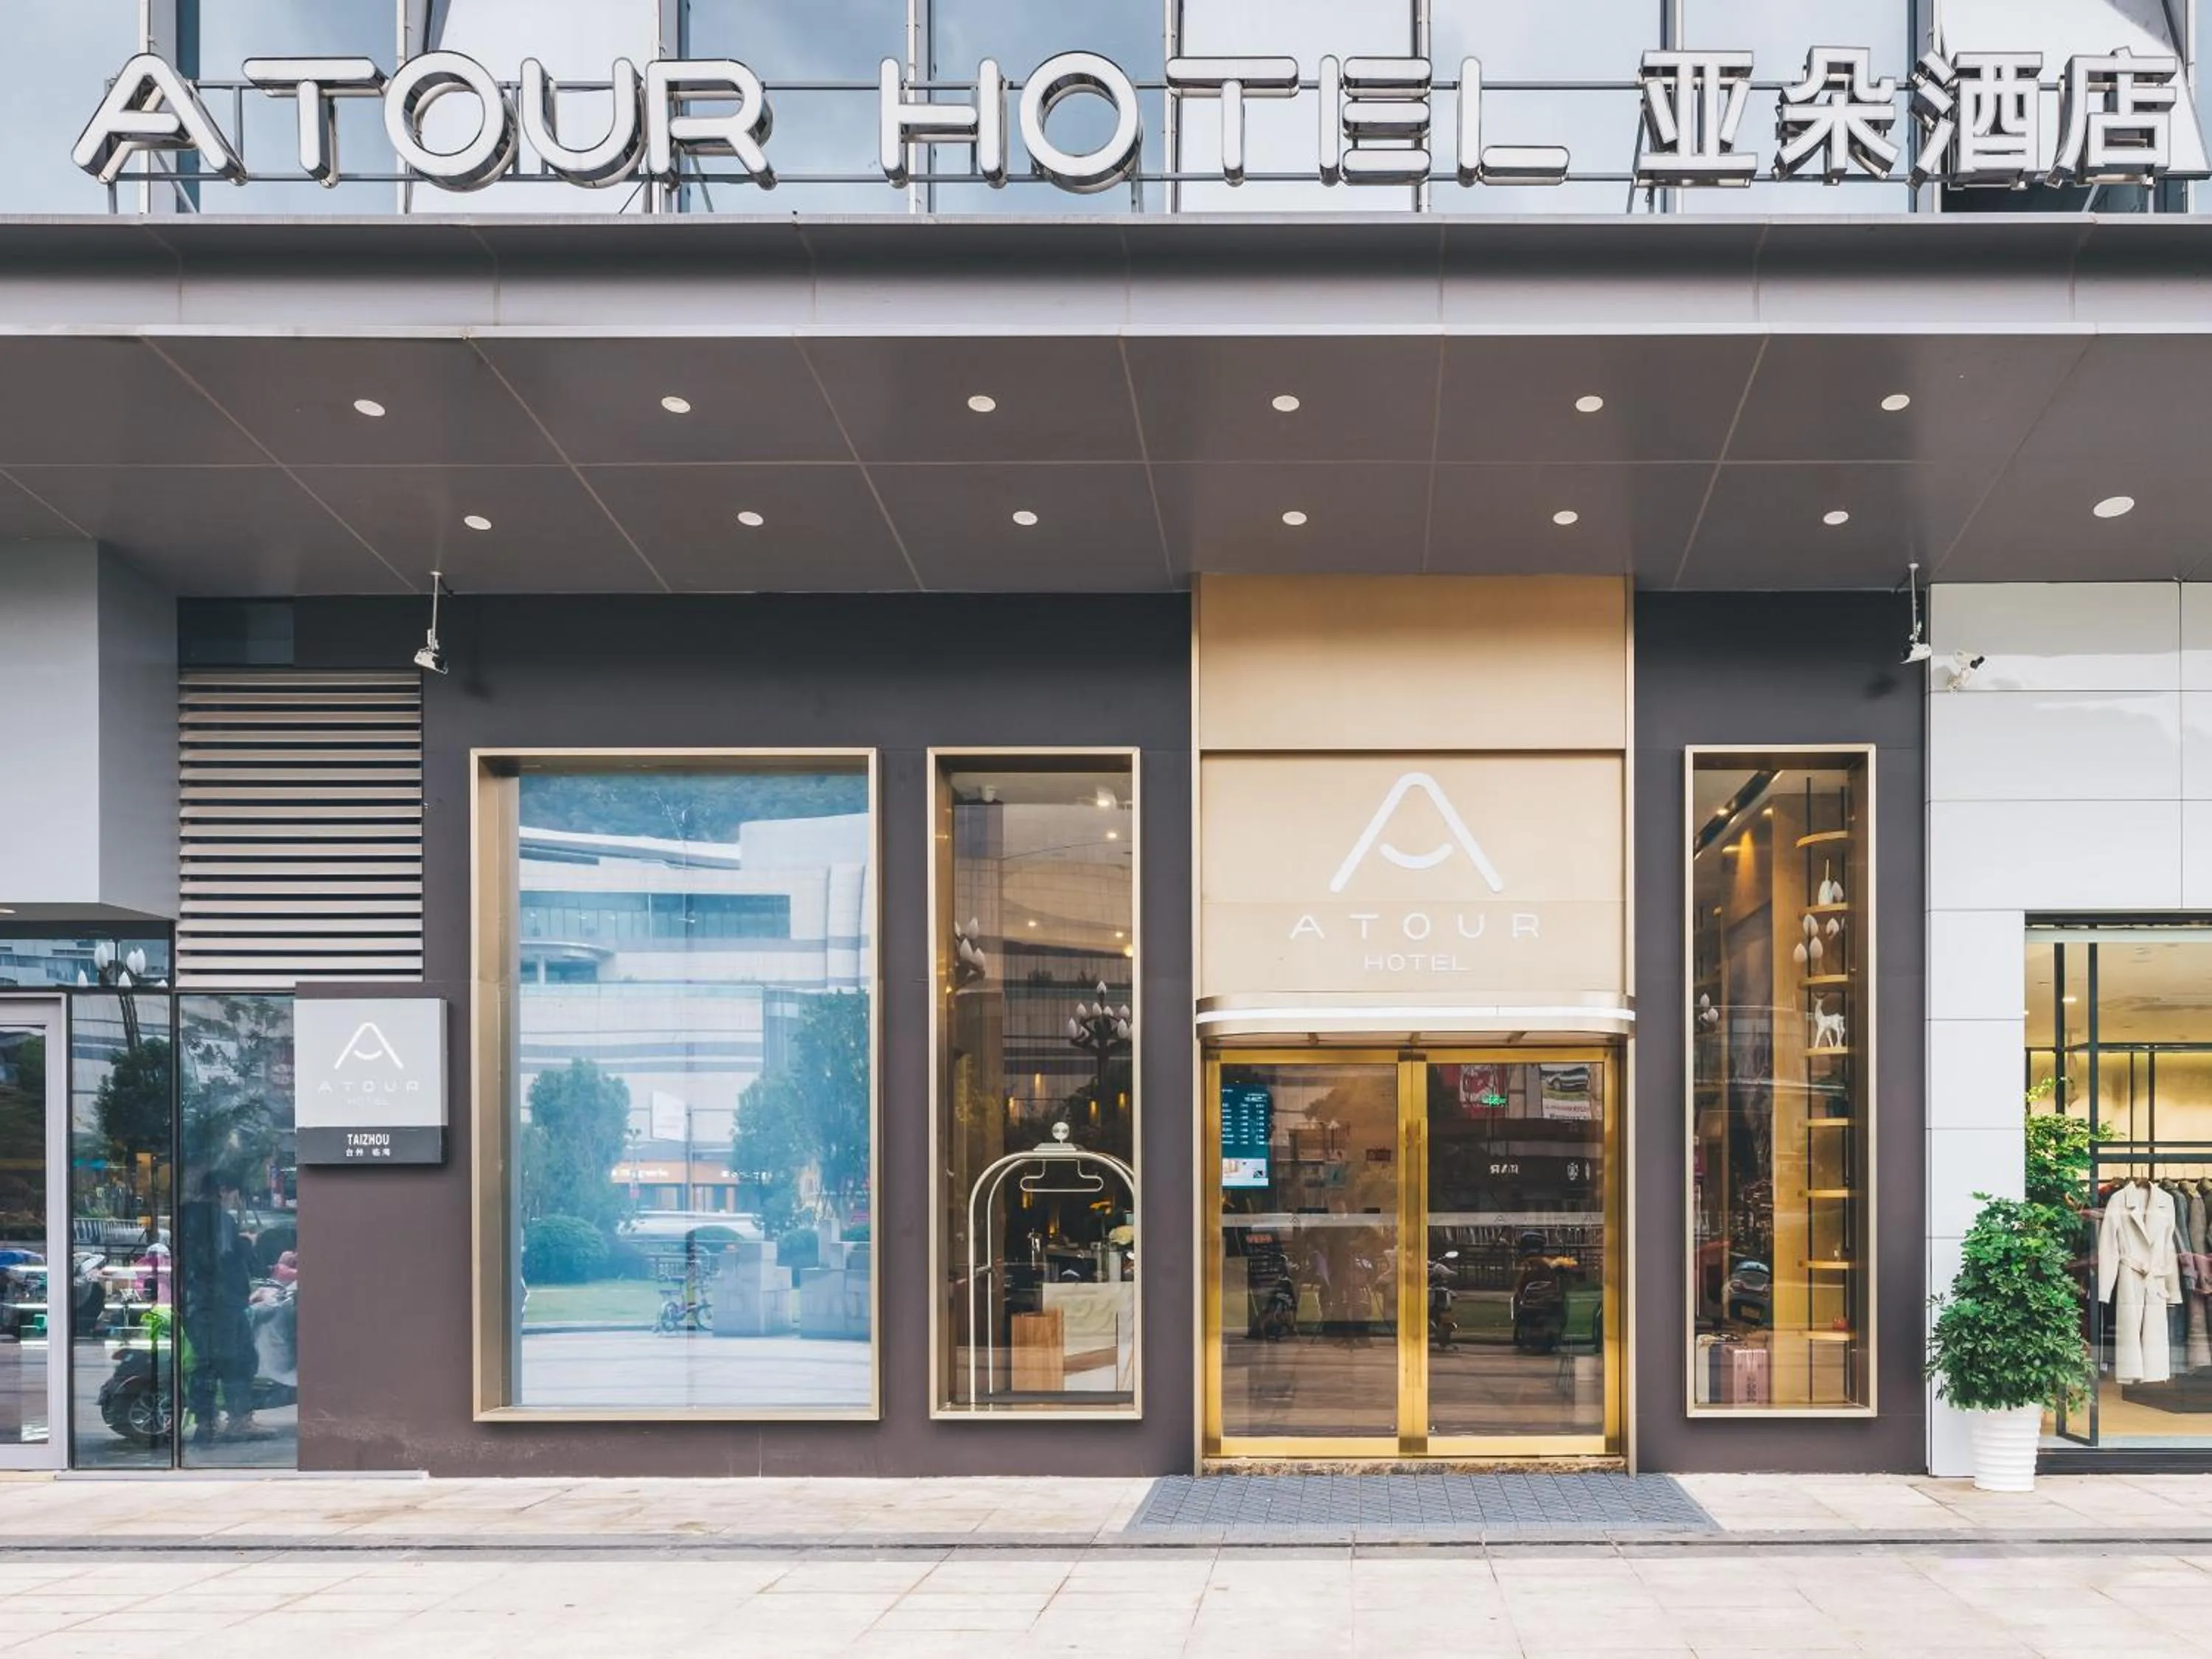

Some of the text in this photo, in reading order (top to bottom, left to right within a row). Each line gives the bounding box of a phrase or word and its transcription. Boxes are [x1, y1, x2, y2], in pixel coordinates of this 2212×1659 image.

[72, 47, 2178, 192] ATOUR HOTEL 亚朵酒店
[1290, 913, 1540, 940] ATOUR
[1365, 954, 1470, 972] HOTEL
[317, 1080, 420, 1094] ATOUR
[347, 1133, 390, 1145] TAIZHOU
